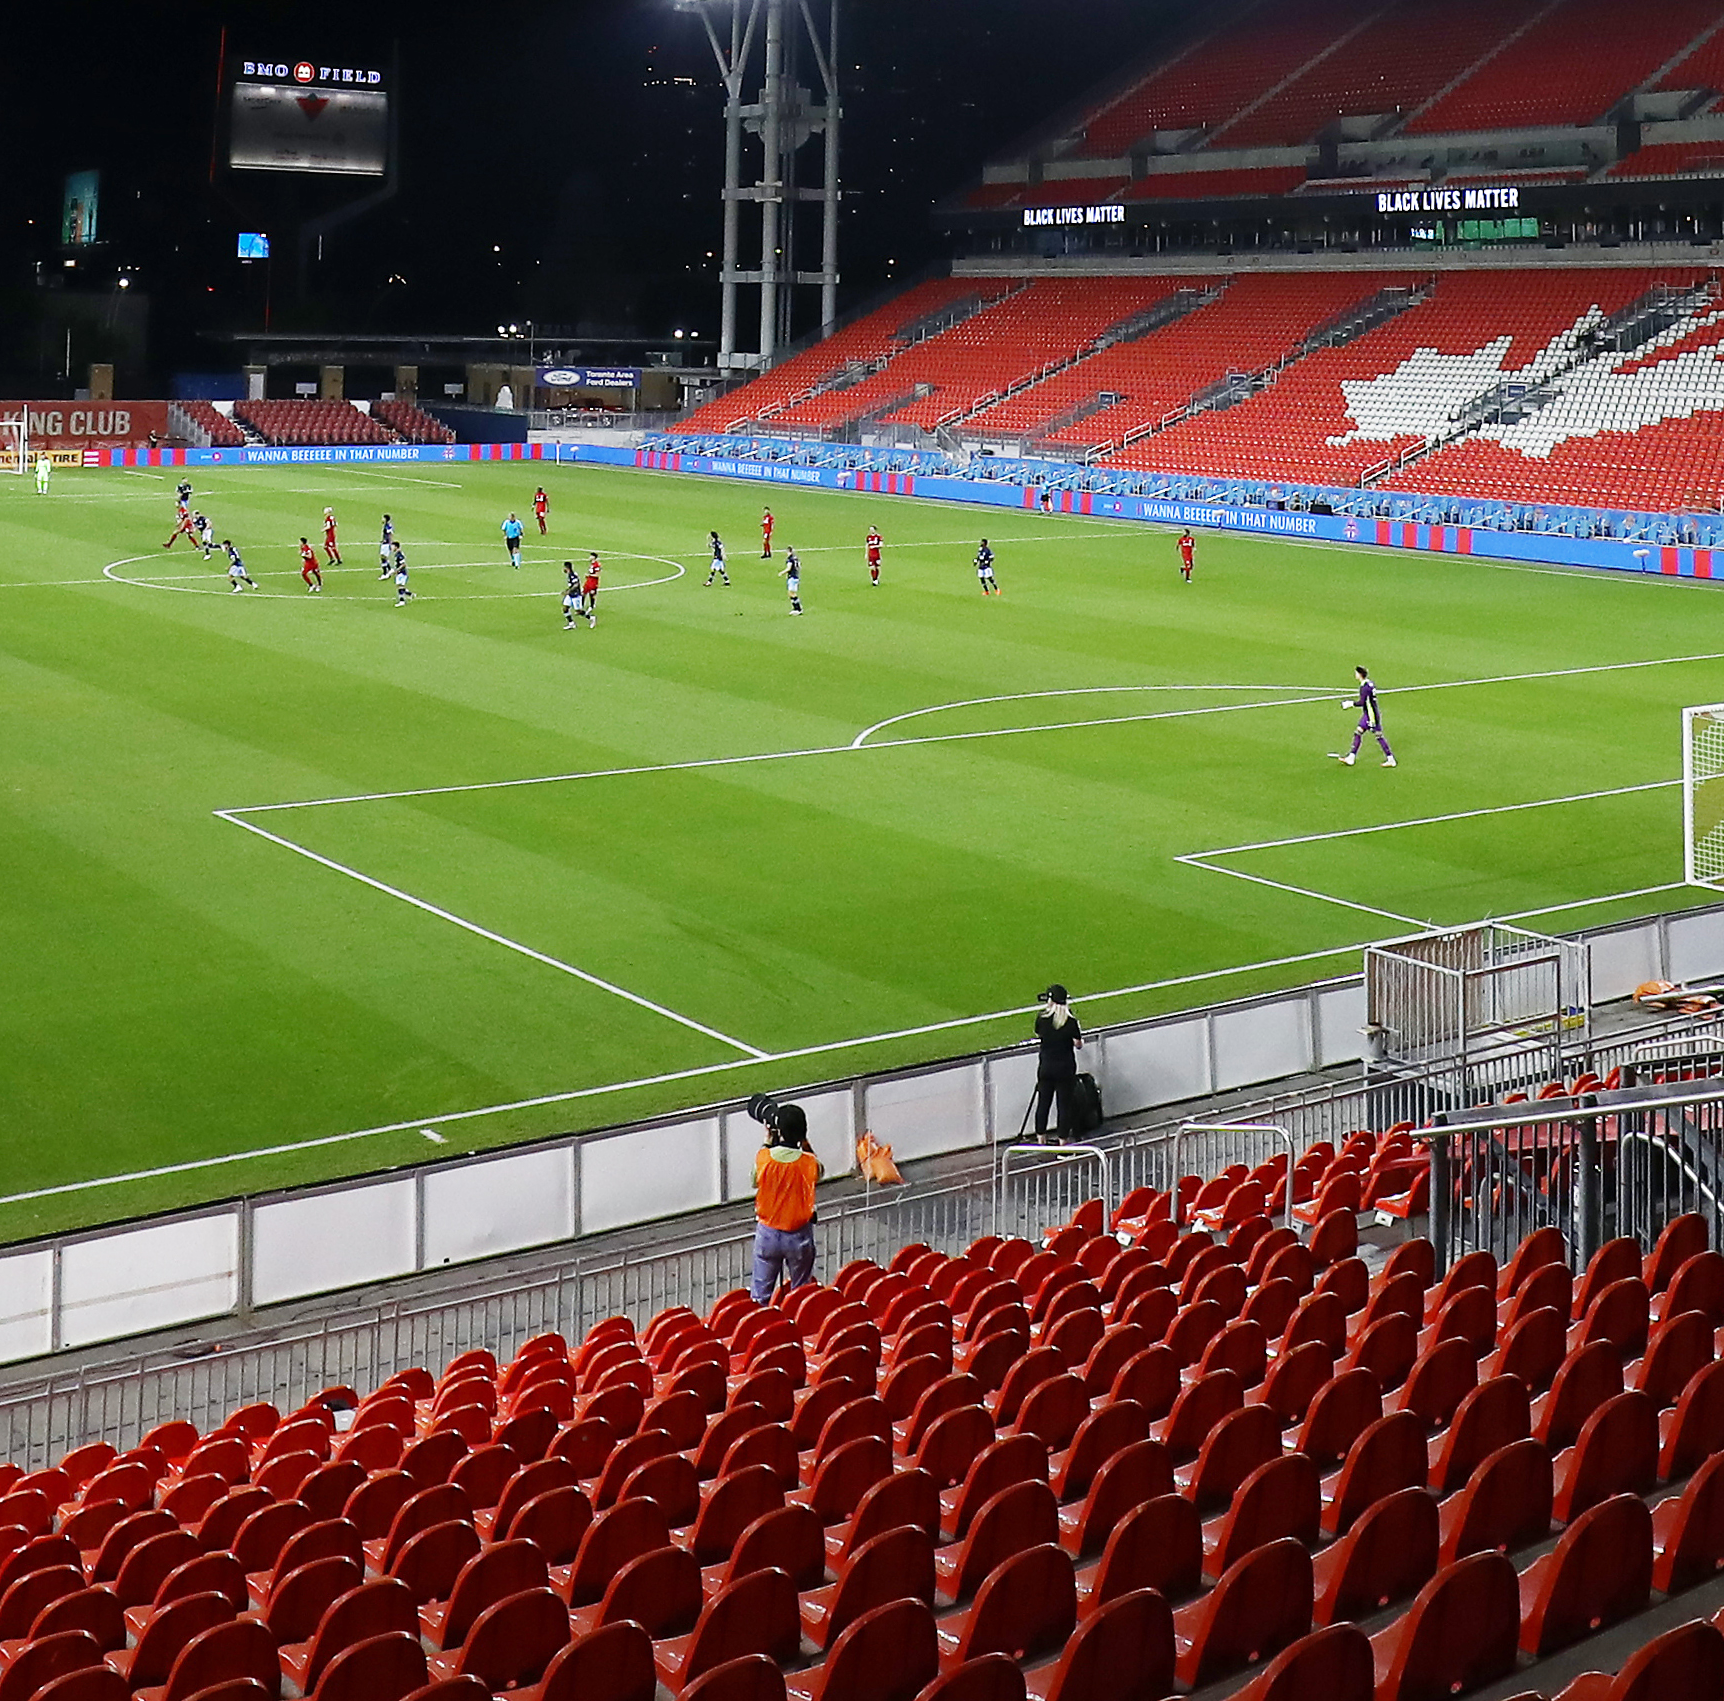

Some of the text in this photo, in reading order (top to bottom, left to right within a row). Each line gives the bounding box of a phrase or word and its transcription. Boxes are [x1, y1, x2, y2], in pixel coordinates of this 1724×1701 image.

[243, 62, 382, 84] BMO FIELD
[1378, 188, 1519, 212] BLACK LIVES MATTER
[1023, 205, 1125, 226] BLACK LIVES MATTER
[604, 379, 634, 387] Dealers
[616, 370, 635, 379] Area
[2, 410, 131, 436] KNG CLUB
[51, 454, 79, 463] TIRE
[247, 452, 289, 461] WANNA
[334, 451, 347, 460] IN
[348, 450, 375, 460] THAT
[377, 449, 419, 460] NUMBER
[1144, 503, 1181, 519] WANNA
[1226, 512, 1237, 525] IN
[1239, 512, 1267, 528] THAT
[1269, 515, 1316, 533] NUMBER
